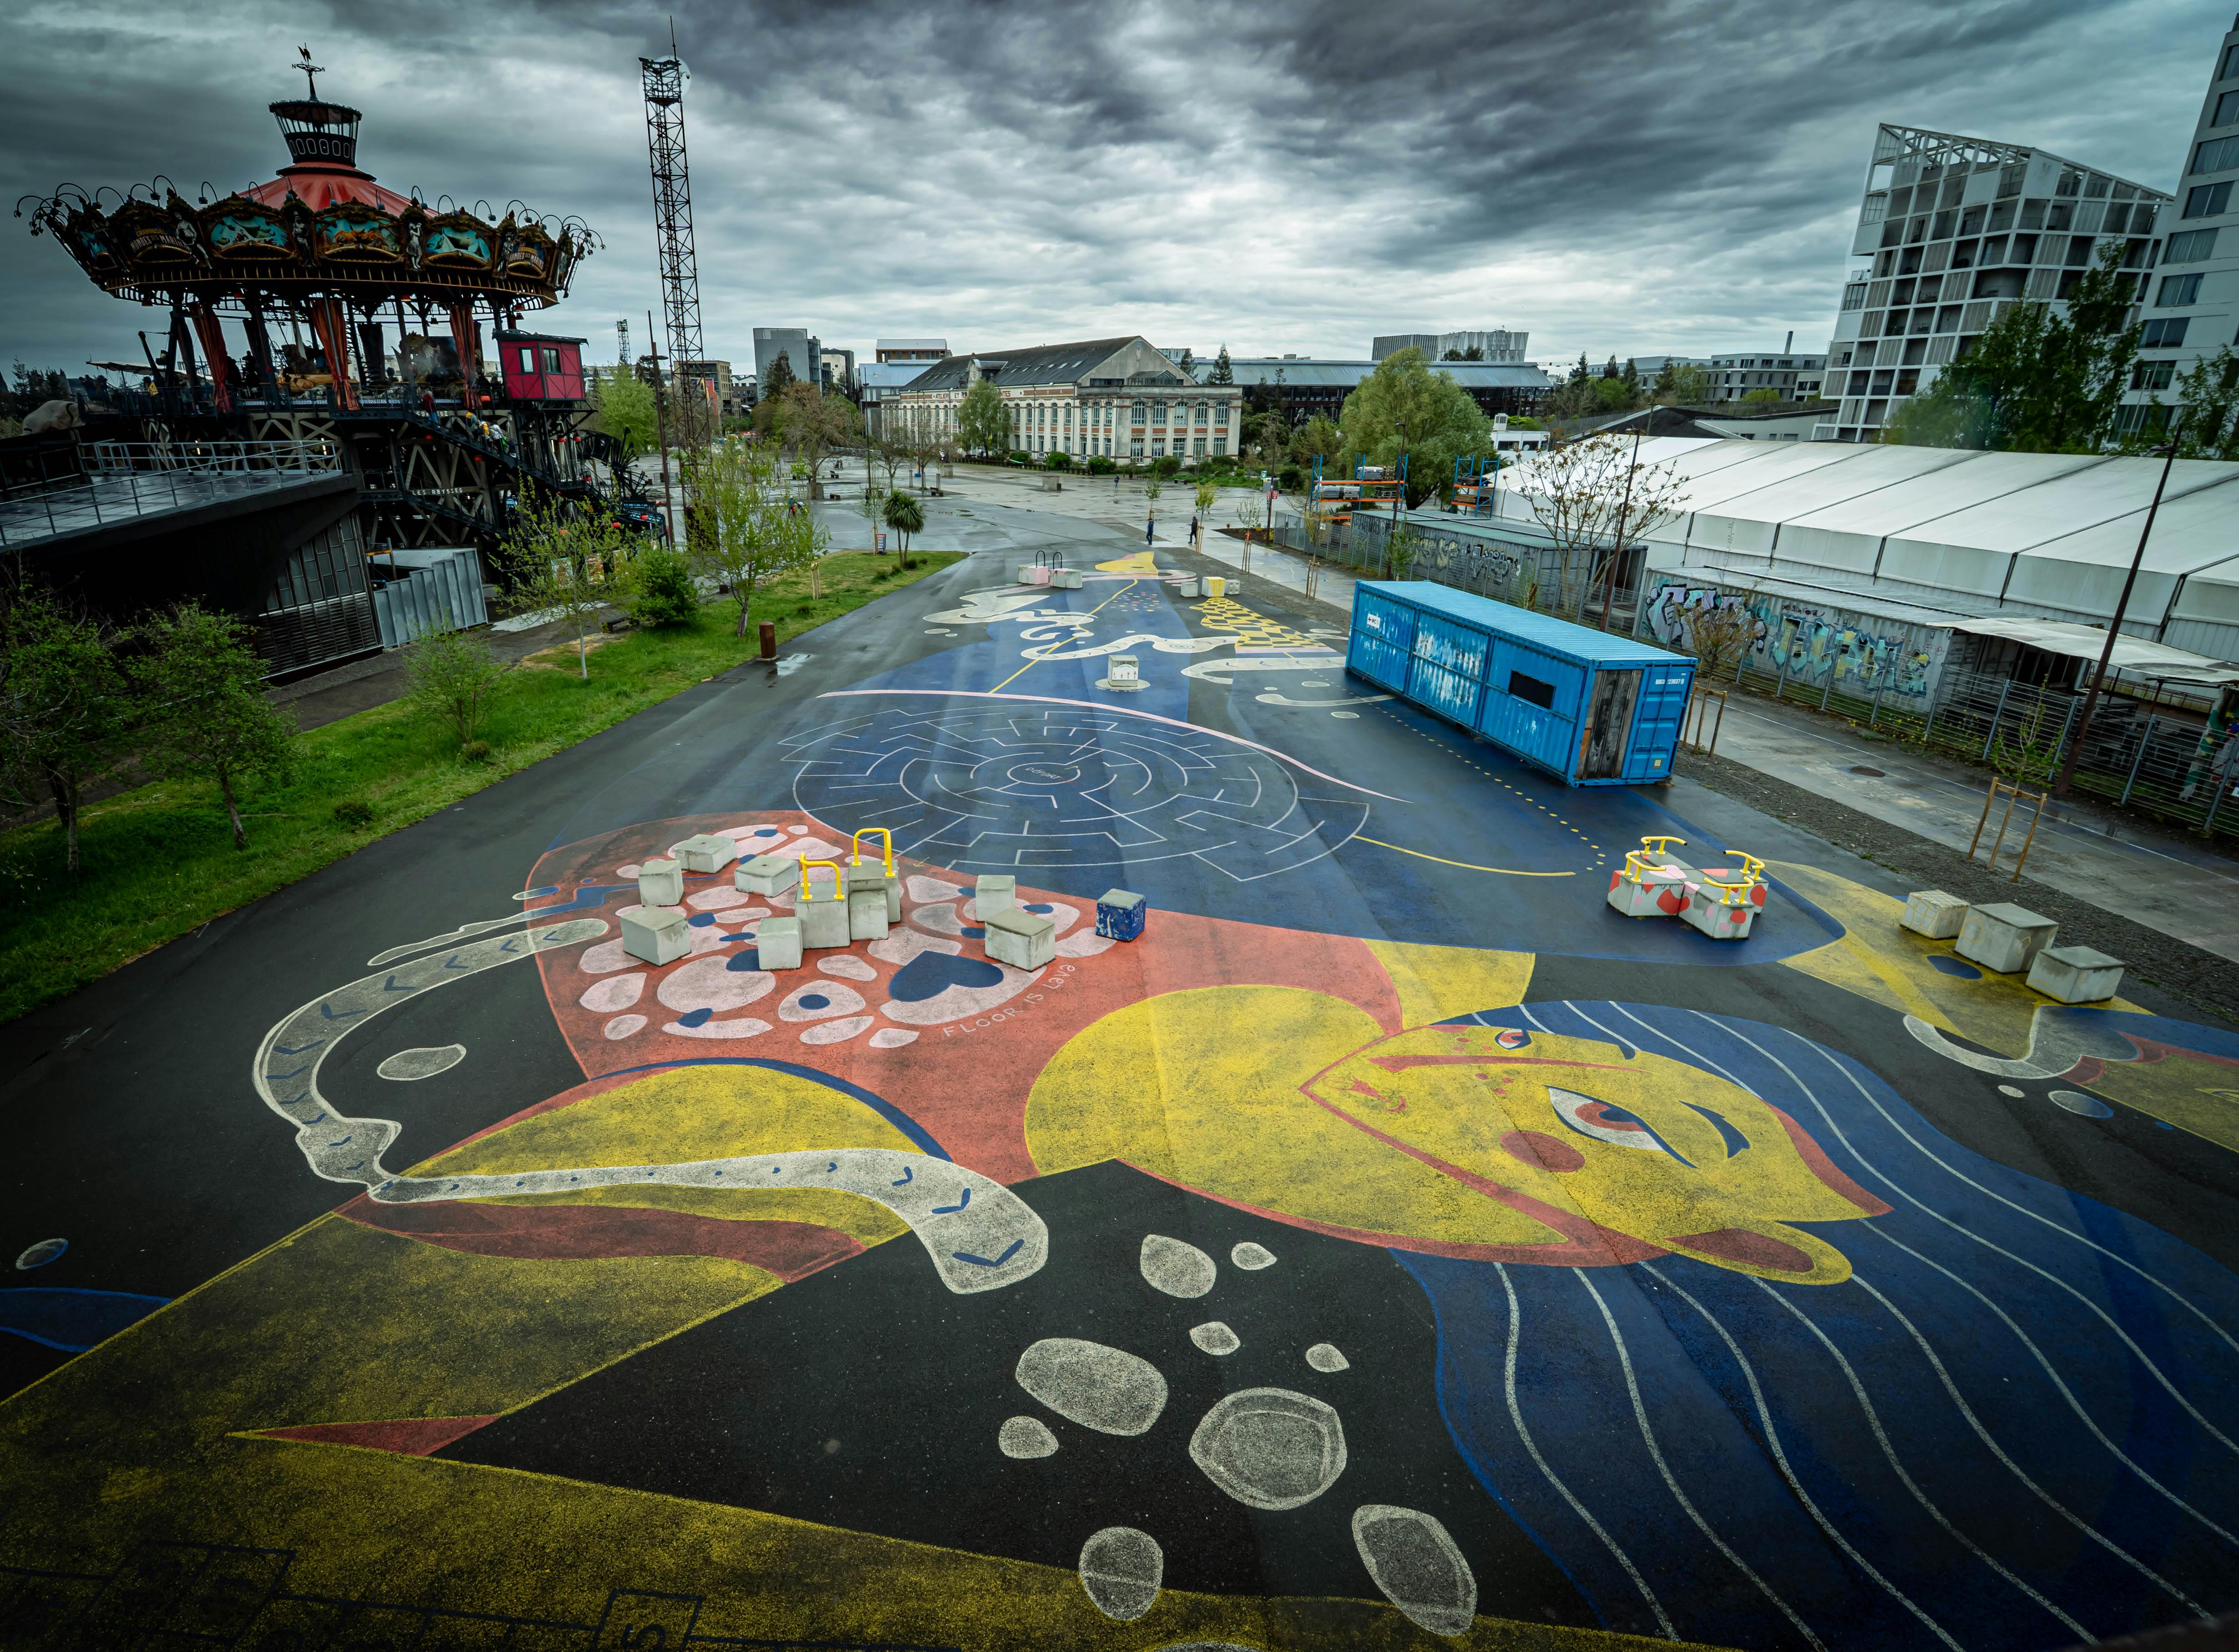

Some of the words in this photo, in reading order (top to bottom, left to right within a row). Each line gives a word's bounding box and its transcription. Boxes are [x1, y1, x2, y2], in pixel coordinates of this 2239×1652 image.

[130, 236, 152, 253] MONDES
[943, 1008, 1023, 1037] FLOOR
[1023, 993, 1044, 1004] IS
